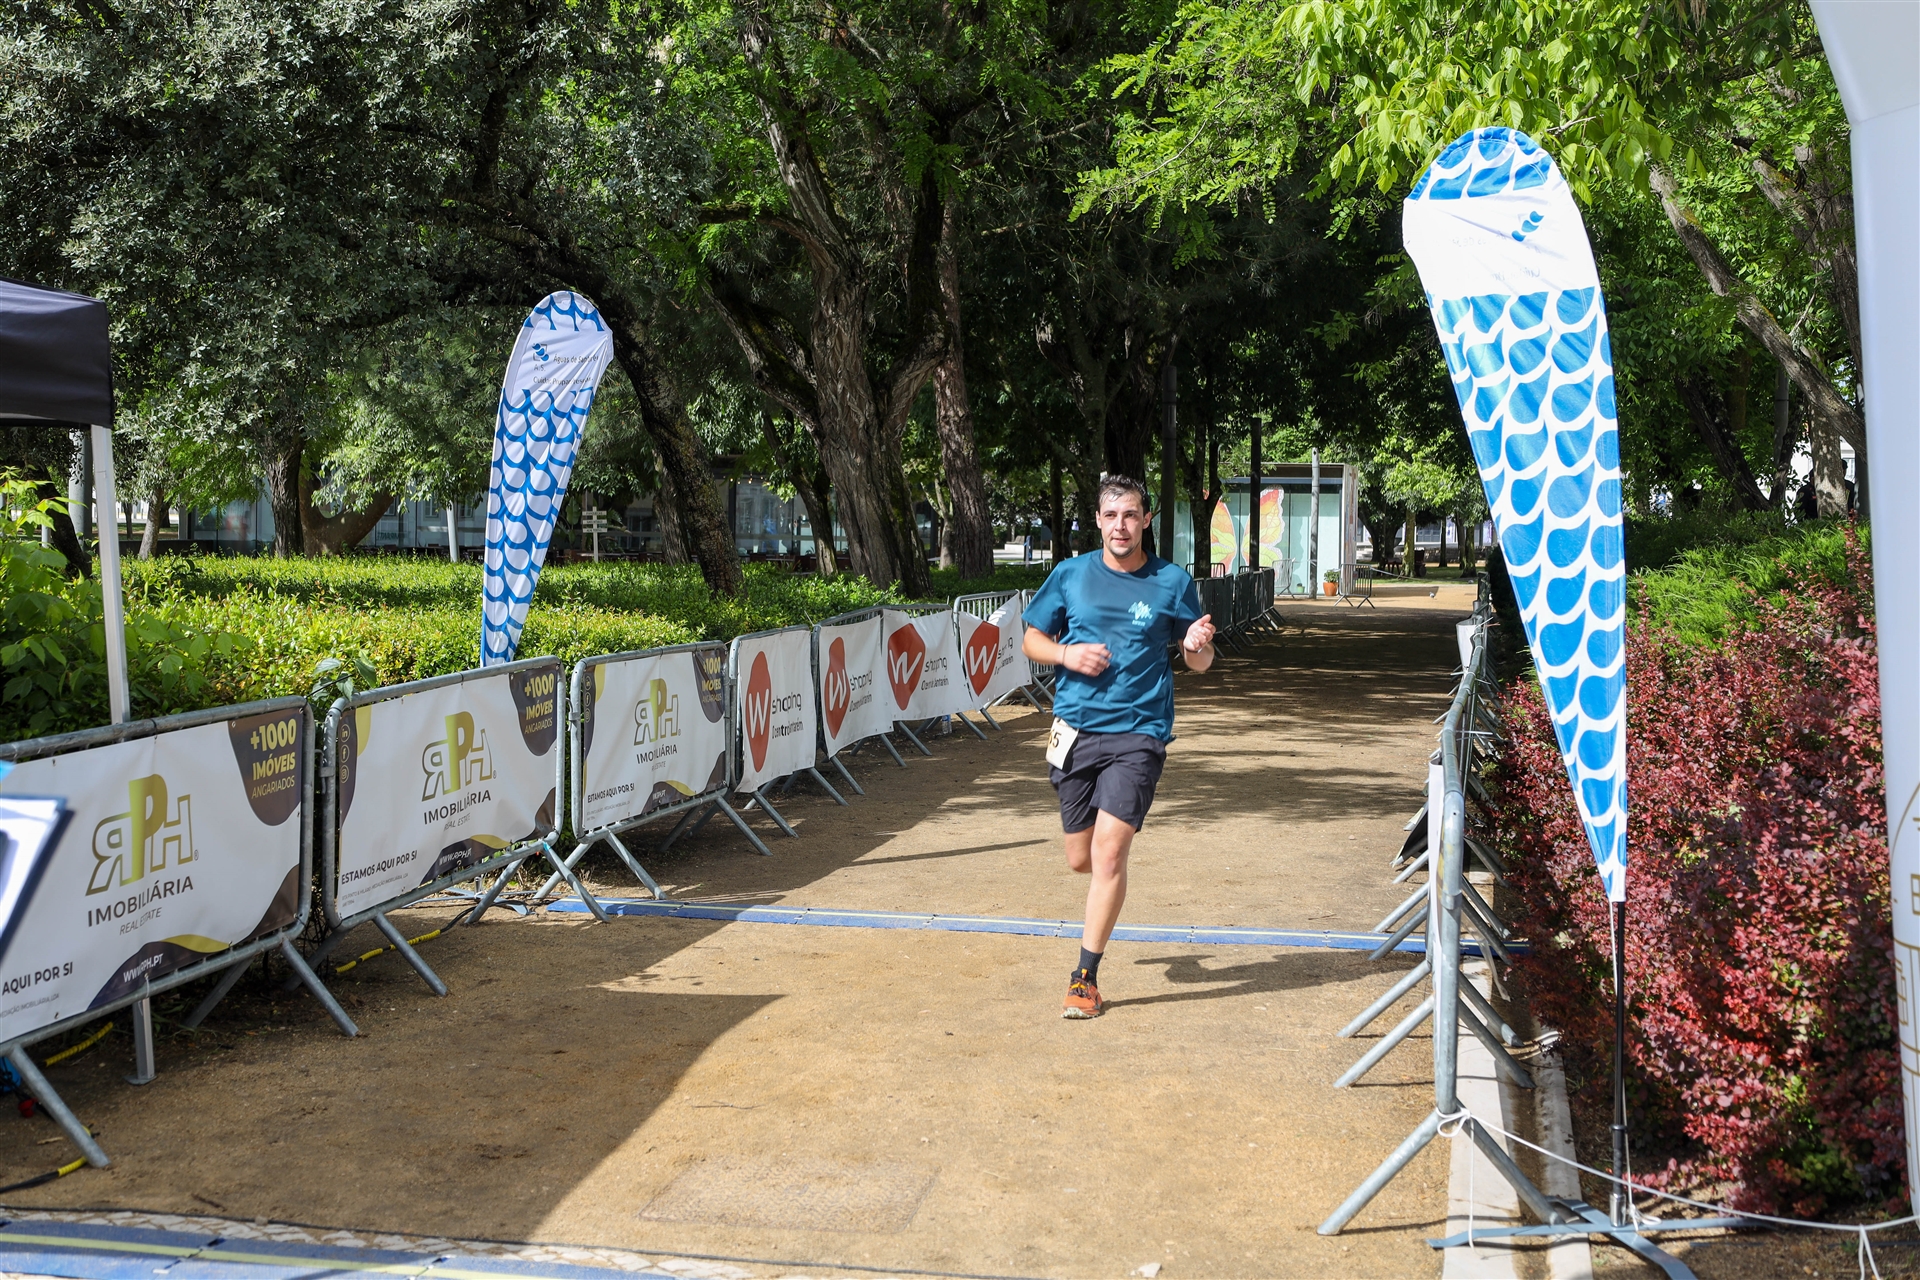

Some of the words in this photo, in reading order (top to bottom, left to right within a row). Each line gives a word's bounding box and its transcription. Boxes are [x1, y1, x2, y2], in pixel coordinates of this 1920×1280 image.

[524, 673, 554, 698] +1000
[526, 699, 553, 720] IMÓVEIS
[250, 718, 297, 751] +1000
[252, 752, 296, 780] IMÓVEIS
[251, 775, 295, 799] ANGARIADOS
[618, 784, 629, 794] POR
[630, 783, 634, 791] SI
[423, 789, 492, 825] IMOBILIÁRIA
[341, 864, 376, 885] ESTAMOS
[376, 858, 395, 872] AQUI
[396, 852, 410, 867] POR
[411, 849, 418, 861] SI
[88, 876, 194, 927] IMOBILIÁRIA
[119, 920, 139, 935] REAL
[2, 973, 31, 996] AQUI
[35, 966, 60, 985] POR
[63, 961, 73, 976] SI
[0, 1004, 20, 1018] EDIAÇÃO
